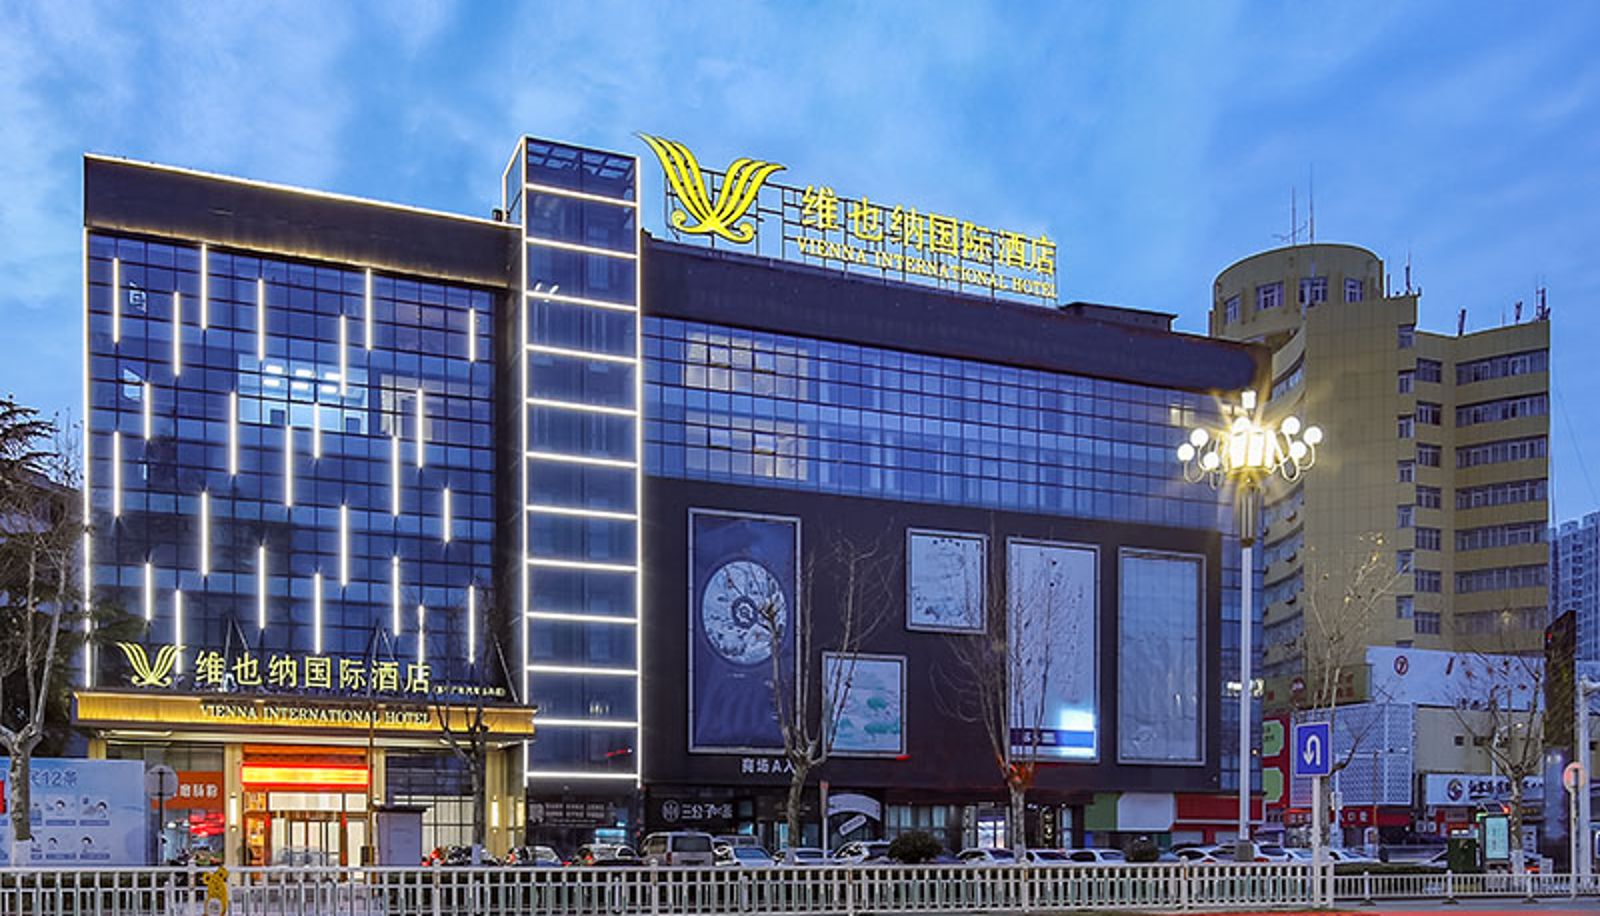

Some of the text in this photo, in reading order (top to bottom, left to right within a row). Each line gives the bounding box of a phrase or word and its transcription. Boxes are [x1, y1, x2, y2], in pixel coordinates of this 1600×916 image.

[801, 185, 1056, 275] 维也纳国际酒店
[797, 236, 1057, 299] VIENNA INTERNATIONAL HOTEL
[195, 651, 432, 693] 维也纳国际酒店
[200, 704, 432, 725] VIENNA INTERNATIONAL HOTEL
